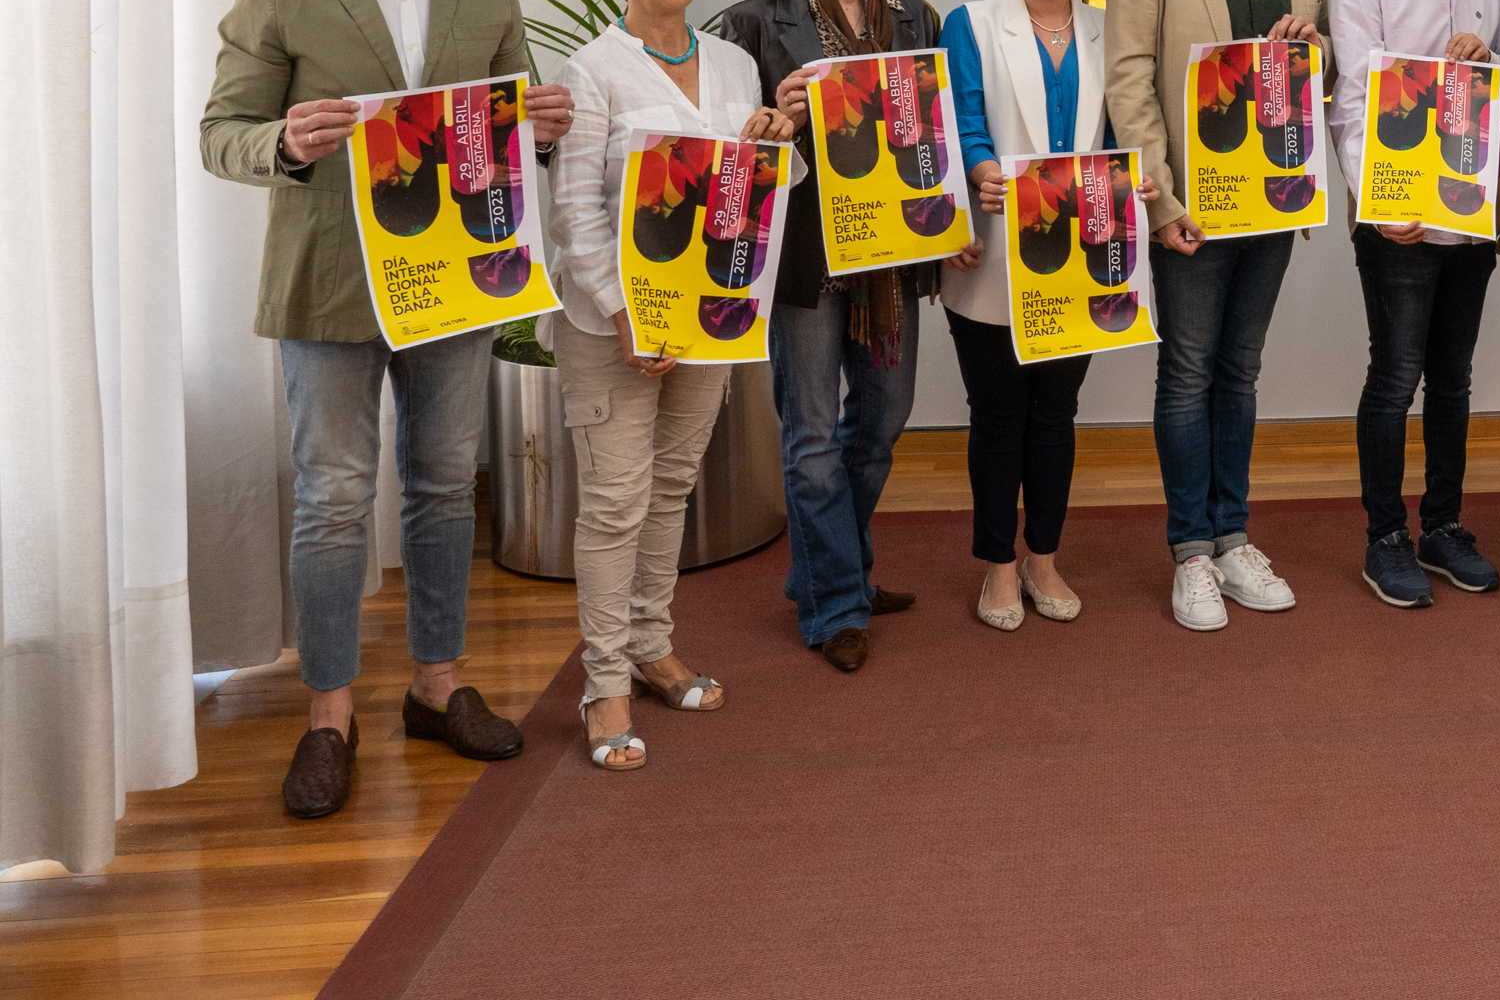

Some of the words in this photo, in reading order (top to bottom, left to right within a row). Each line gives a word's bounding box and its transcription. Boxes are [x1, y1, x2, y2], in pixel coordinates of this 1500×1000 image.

[1262, 53, 1272, 88] ABRIL
[889, 68, 901, 105] ABRIL
[1275, 63, 1283, 116] CARTAGENA
[1445, 71, 1455, 101] ABRIL
[903, 78, 915, 134] CARTAGENA
[1456, 82, 1464, 127] CARTAGENA
[455, 100, 468, 144] ABRIL
[472, 111, 485, 177] CARTAGENA
[1288, 126, 1297, 154] 2023
[920, 144, 932, 174] 2023
[1464, 138, 1473, 164] 2023
[720, 154, 735, 194] ABRIL
[1198, 165, 1217, 175] DÍA
[1374, 160, 1393, 169] DÍA
[1083, 166, 1095, 203] ABRIL
[1198, 175, 1250, 184] INTERNA-
[1198, 185, 1240, 193] CIONAL
[491, 188, 505, 224] 2023
[729, 167, 746, 228] CARTAGENA
[832, 194, 852, 205] DÍA
[1097, 176, 1108, 232] CARTAGENA
[1199, 202, 1238, 211] DANZA
[1217, 194, 1231, 202] LA
[832, 200, 886, 215] INTERNA-
[833, 211, 877, 224] CIONAL
[835, 225, 850, 234] DE
[854, 222, 869, 231] LA
[836, 231, 877, 244] DANZA
[383, 255, 409, 270] DÍA
[734, 241, 749, 274] 2023
[1111, 242, 1120, 271] 2023
[385, 260, 450, 282] INTERNA-
[387, 274, 440, 293] CIONAL
[632, 275, 650, 287] DÍA
[390, 292, 409, 304] DE
[413, 287, 432, 299] LA
[633, 297, 671, 309] CIONAL
[1022, 289, 1042, 300] DÍA
[1023, 296, 1075, 309] INTERNA-
[393, 297, 443, 316] DANZA
[1023, 307, 1065, 319] CIONAL
[1024, 319, 1039, 328] DE
[1042, 317, 1057, 326] LA
[1025, 326, 1065, 338] DANZA
